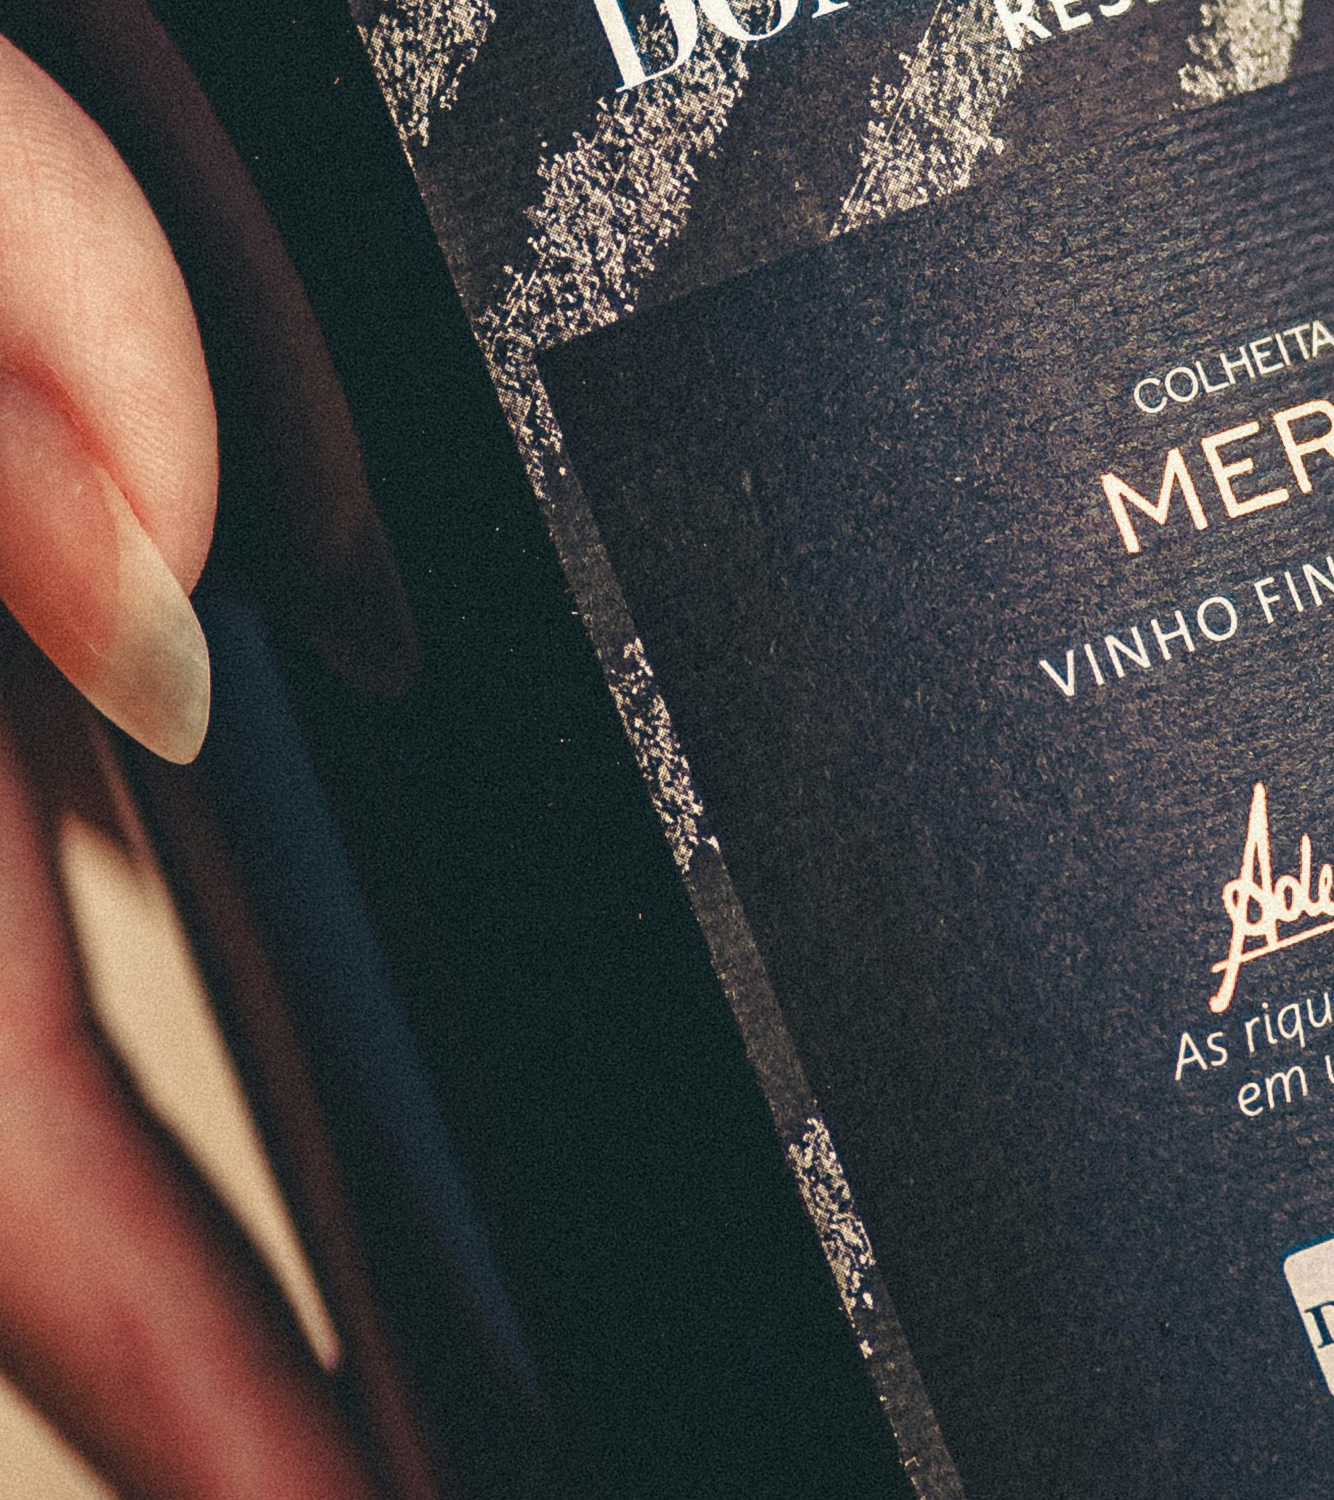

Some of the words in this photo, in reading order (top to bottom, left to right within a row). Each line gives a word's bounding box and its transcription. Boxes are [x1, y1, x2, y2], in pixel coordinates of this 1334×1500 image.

[1039, 596, 1238, 698] VINHO
[1174, 1030, 1227, 1082] As
[1237, 1063, 1309, 1118] em
